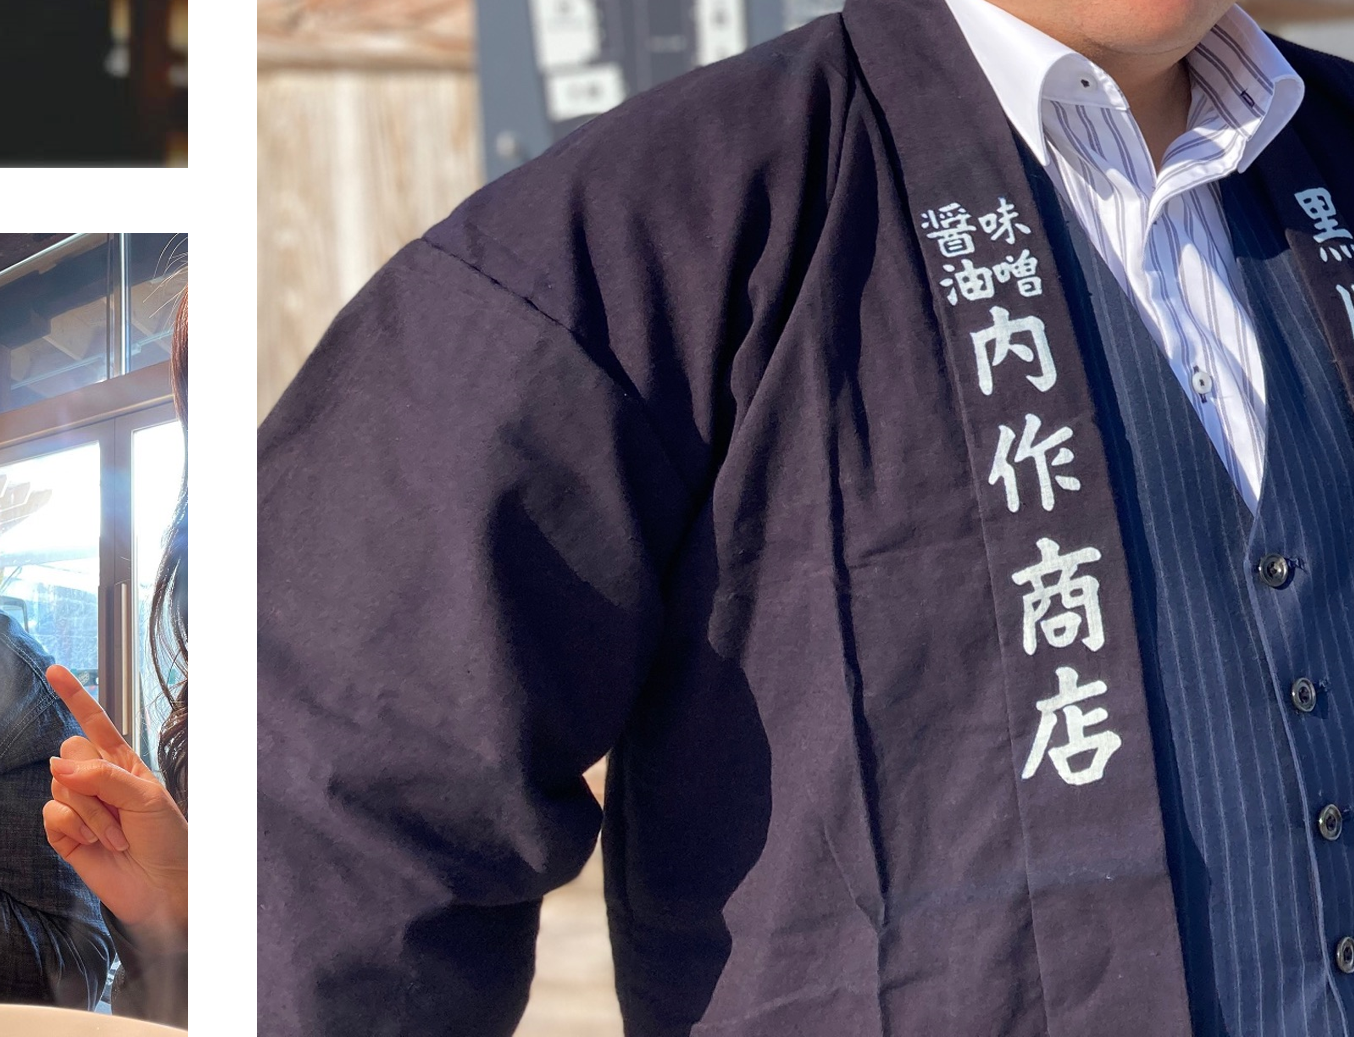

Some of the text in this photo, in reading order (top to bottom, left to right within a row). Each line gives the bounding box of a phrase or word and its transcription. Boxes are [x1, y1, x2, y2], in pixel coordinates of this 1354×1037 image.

[978, 197, 1043, 298] 味噌
[970, 305, 1123, 787] 内作商店
